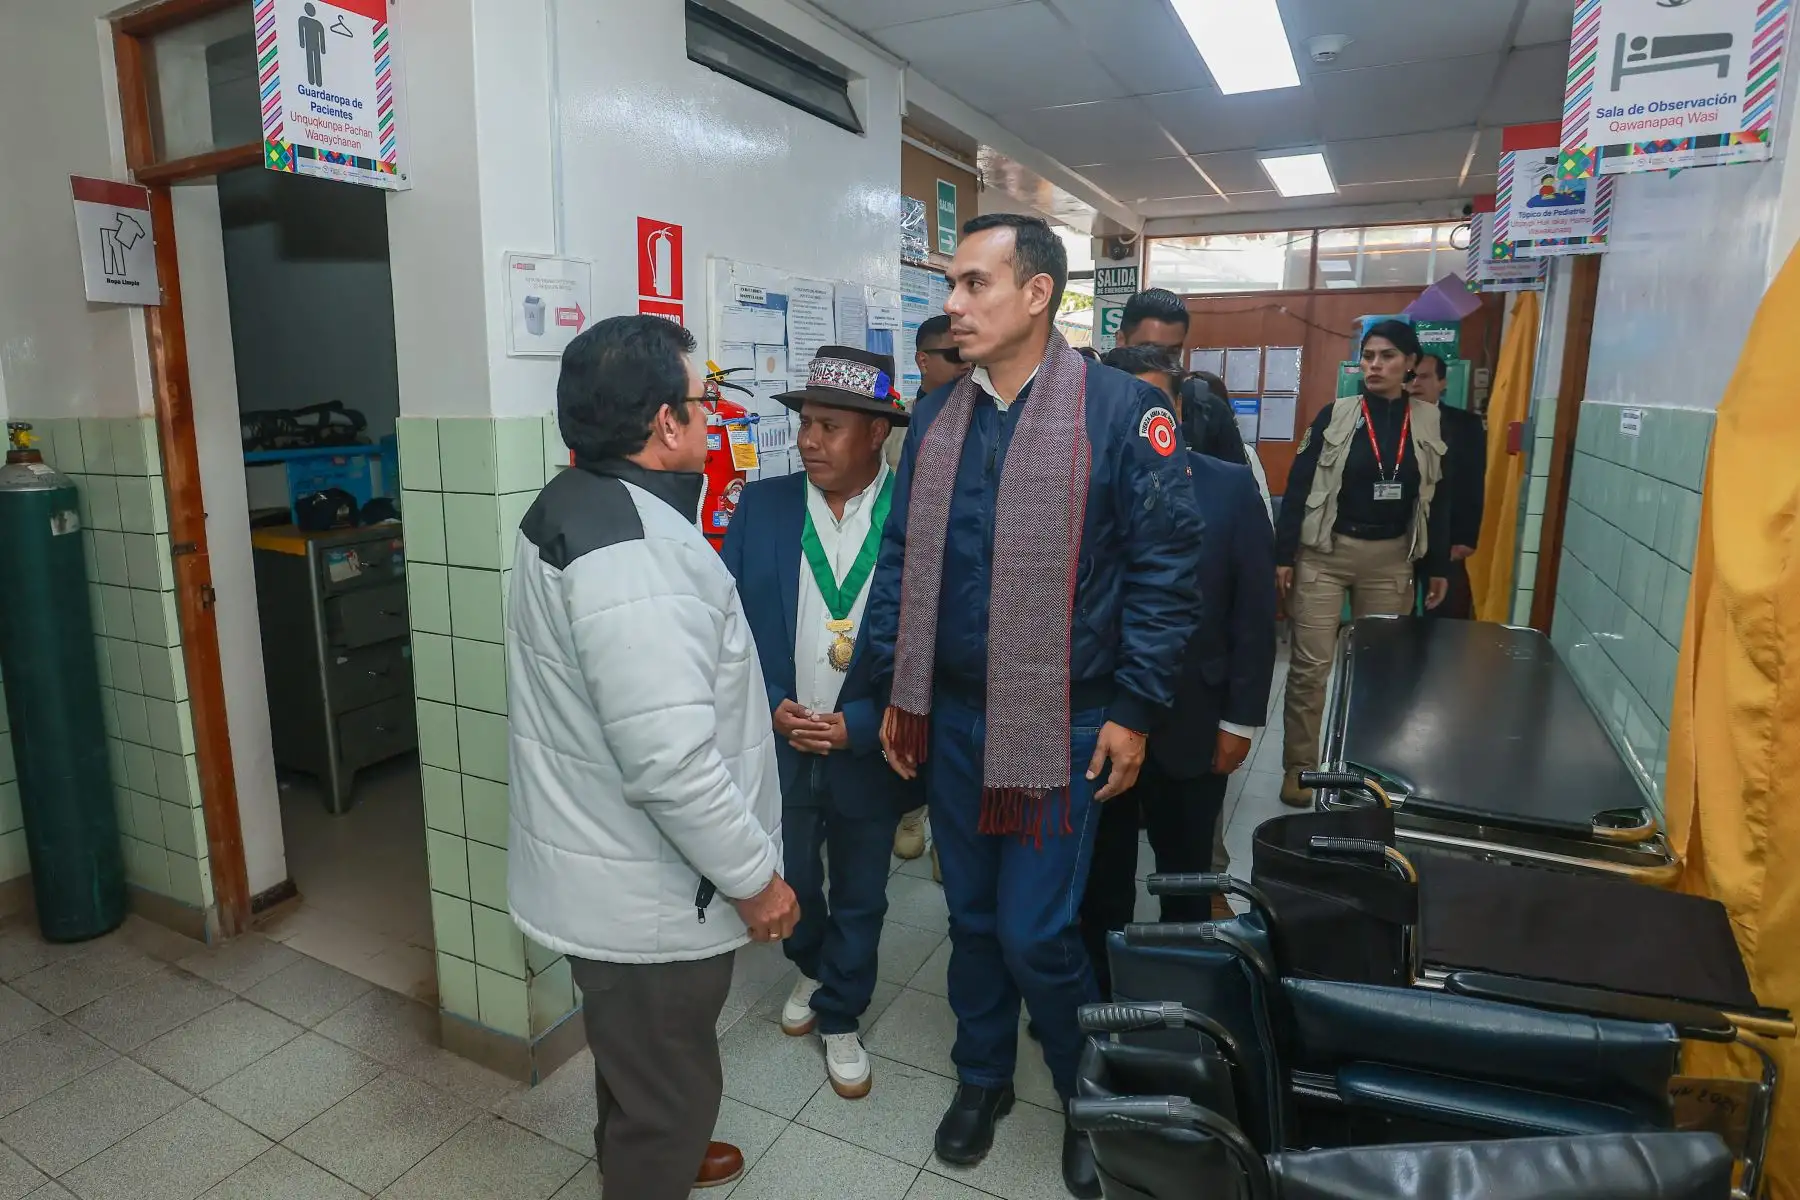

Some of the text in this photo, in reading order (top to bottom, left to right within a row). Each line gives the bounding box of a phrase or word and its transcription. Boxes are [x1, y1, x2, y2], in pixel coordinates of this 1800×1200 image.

[297, 84, 363, 109] Guardaropa de
[1596, 93, 1737, 119] Sala de Observación
[310, 101, 353, 120] Pacientes
[344, 122, 373, 138] Pachan
[1609, 109, 1719, 132] Qawanapaq Wasi
[939, 198, 955, 215] SALIDA
[1543, 209, 1552, 217] de
[1097, 268, 1136, 288] SALIDA
[1097, 286, 1136, 295] DE EMERGENCIA
